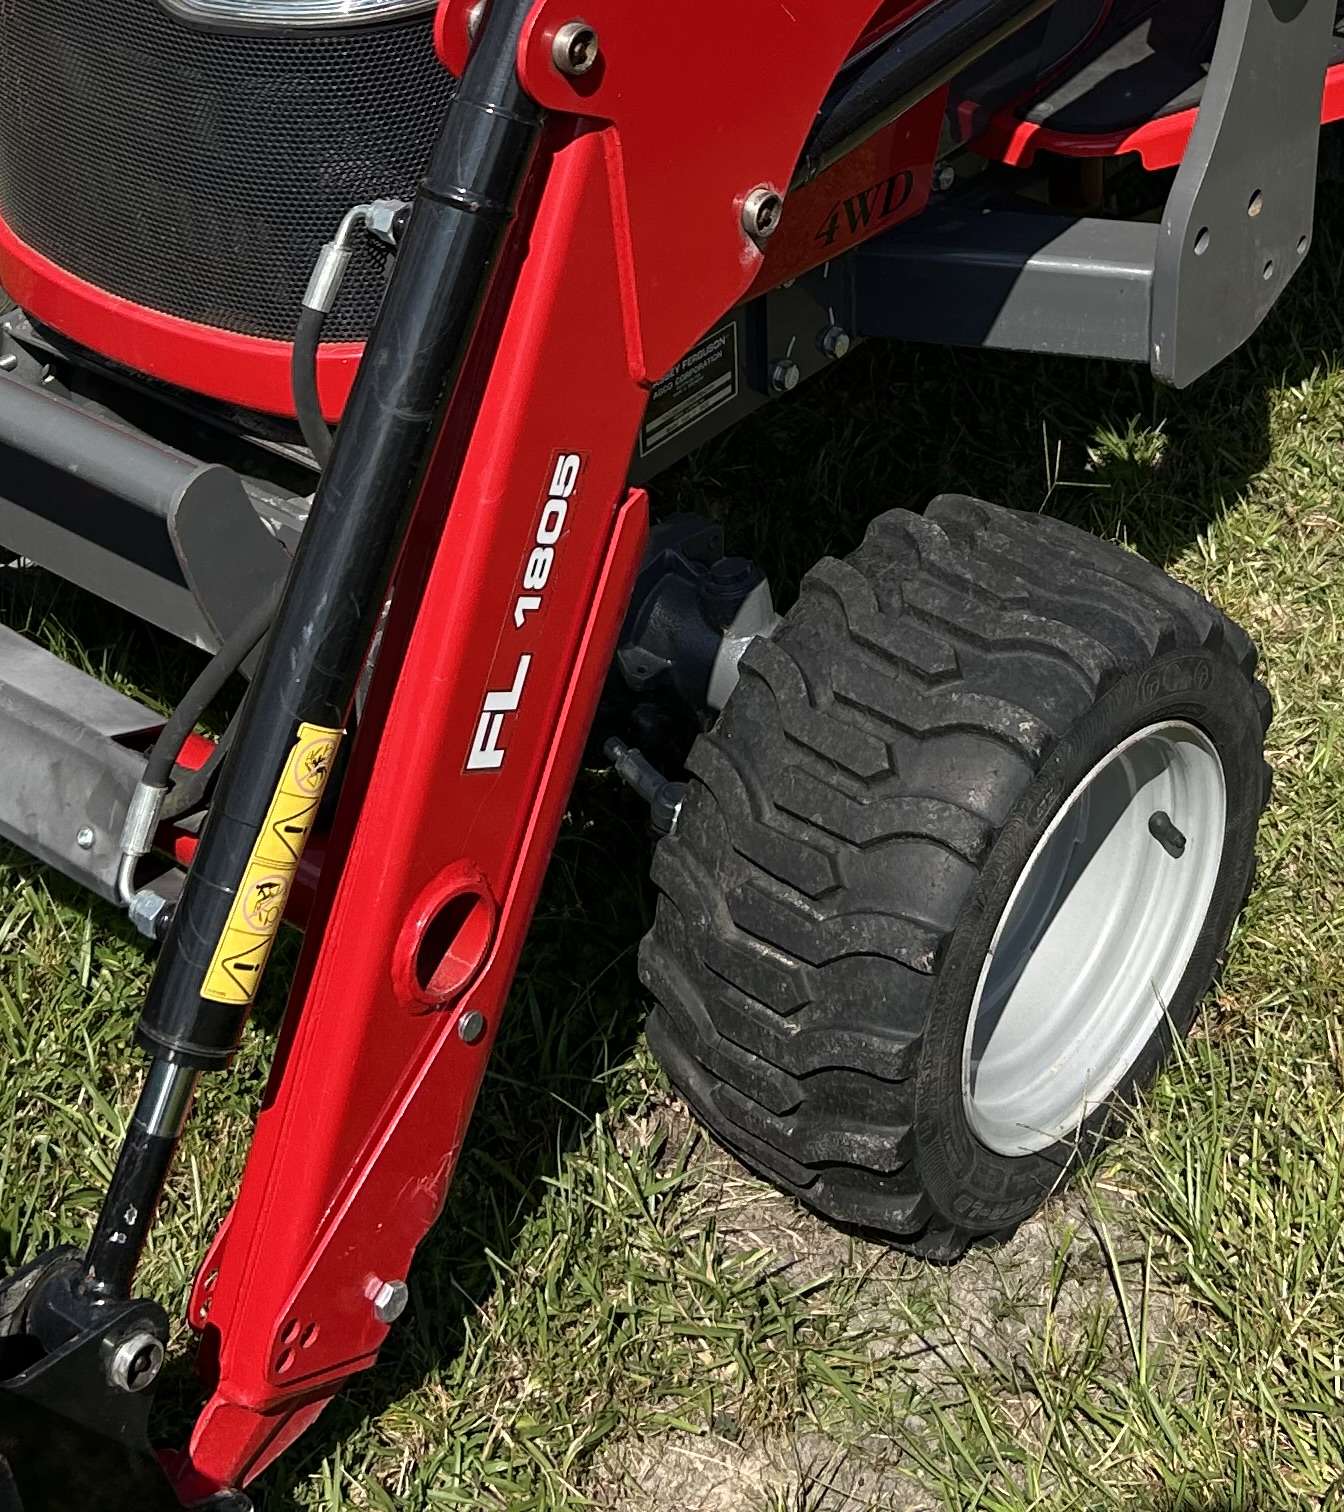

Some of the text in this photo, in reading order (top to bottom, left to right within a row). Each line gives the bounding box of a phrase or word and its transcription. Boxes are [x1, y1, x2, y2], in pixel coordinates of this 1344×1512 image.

[814, 170, 914, 248] 4WD
[466, 454, 581, 770] FL 1805
